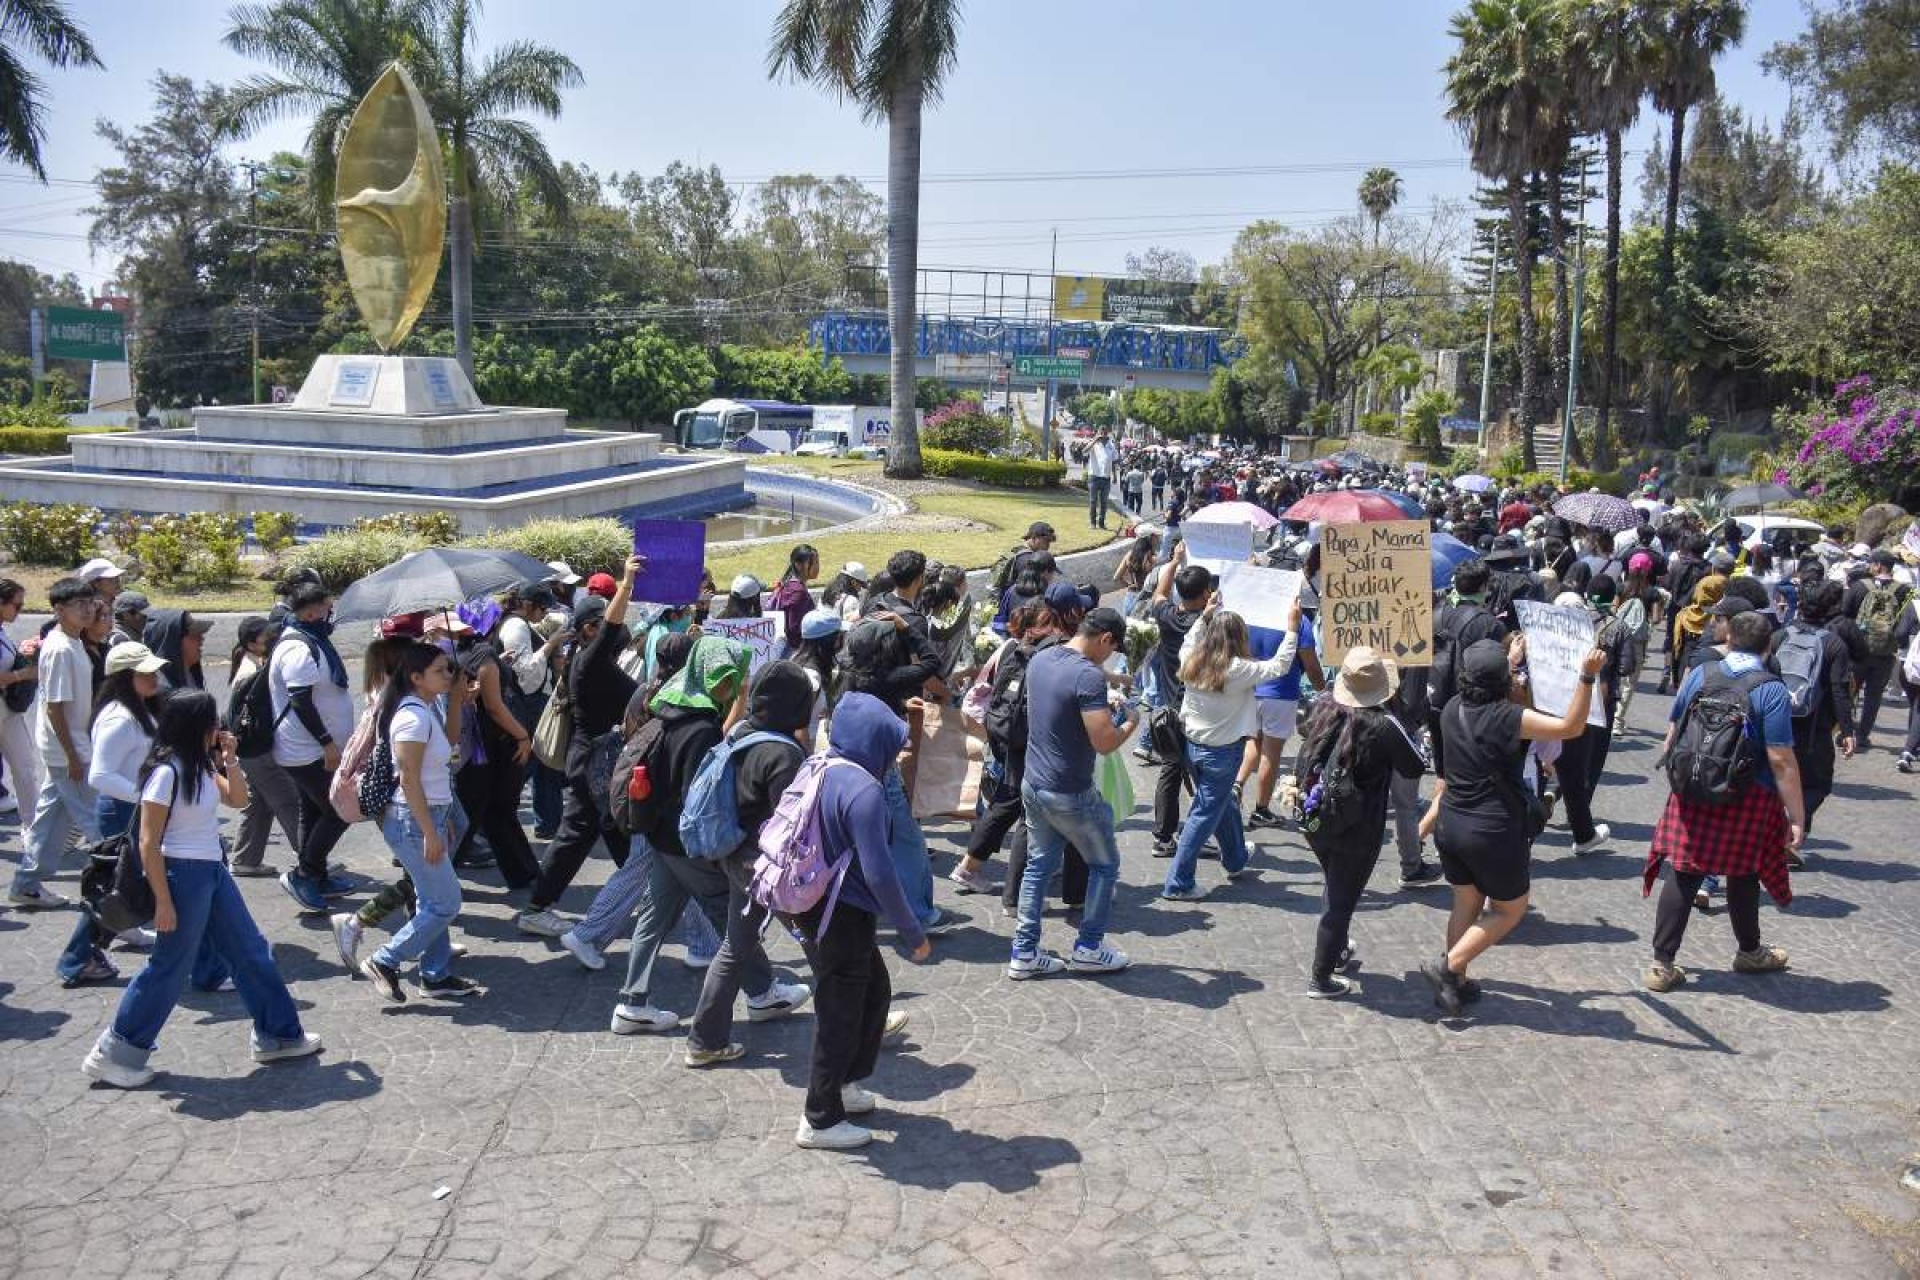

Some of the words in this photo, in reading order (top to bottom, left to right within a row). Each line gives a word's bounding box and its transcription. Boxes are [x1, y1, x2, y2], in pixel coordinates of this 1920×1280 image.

[1109, 304, 1140, 313] TOTAL
[1372, 528, 1425, 547] Mamá
[1381, 556, 1393, 571] a
[1326, 573, 1404, 598] Estudiar
[1333, 600, 1380, 624] OREN
[1333, 627, 1363, 649] POR
